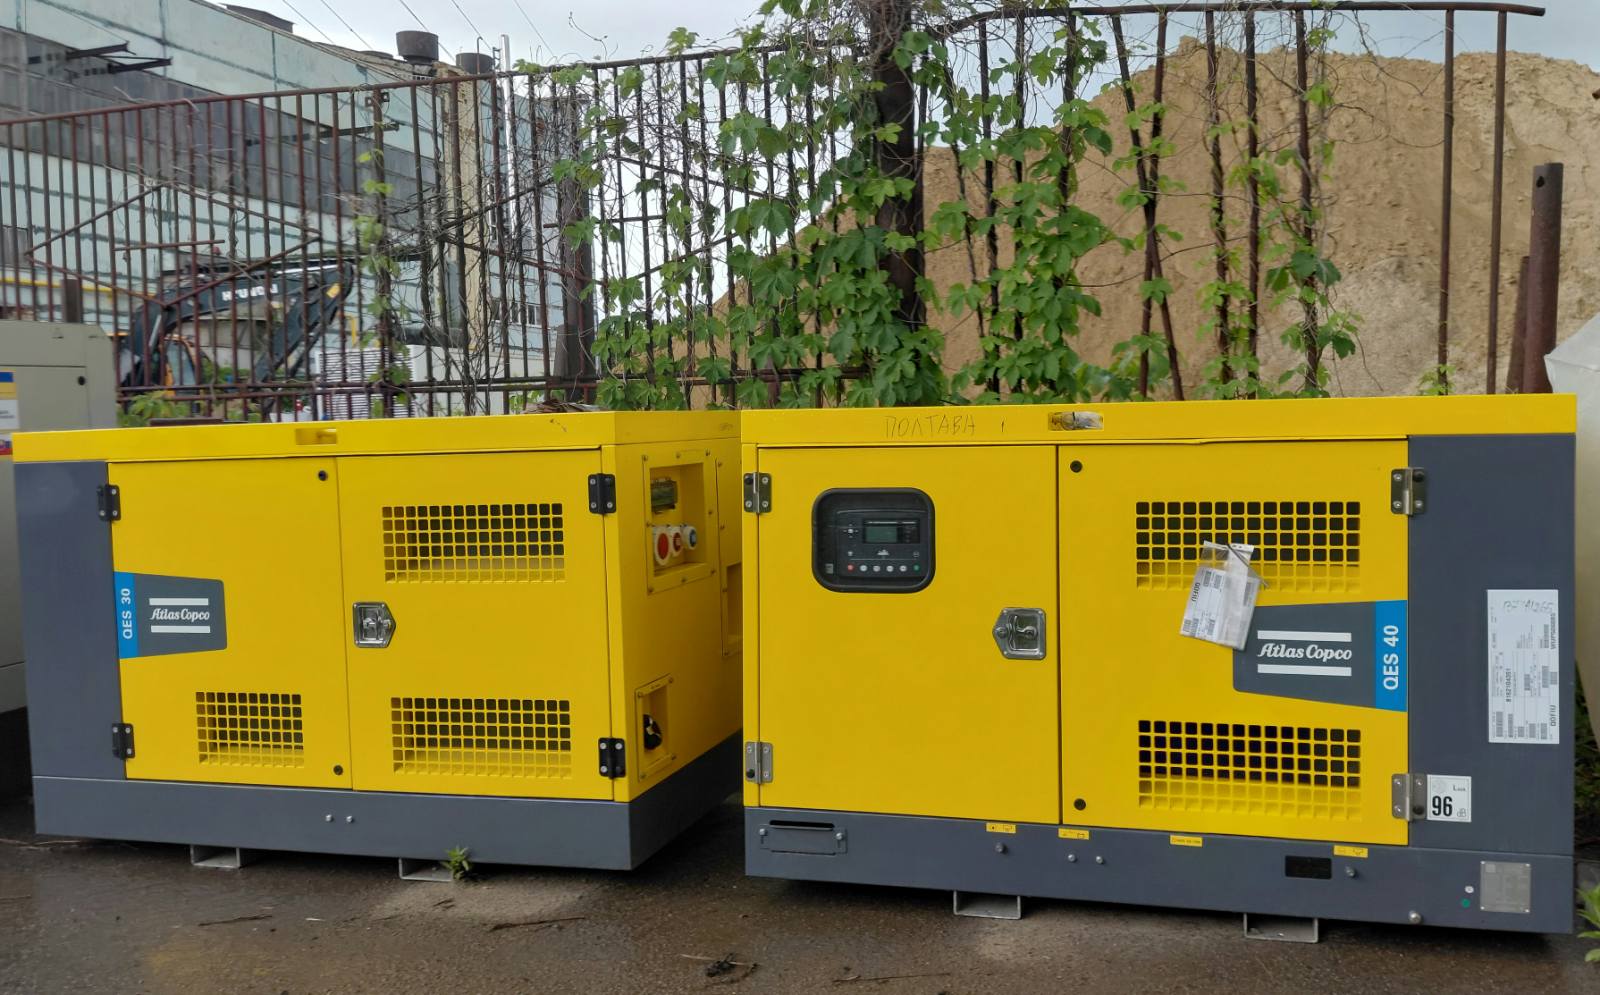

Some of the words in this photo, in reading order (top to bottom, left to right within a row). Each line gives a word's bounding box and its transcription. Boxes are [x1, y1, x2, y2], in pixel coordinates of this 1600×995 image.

[120, 588, 131, 605] 30
[122, 610, 133, 640] QES
[150, 608, 180, 621] Atlas
[180, 608, 210, 622] Copco
[1383, 625, 1399, 647] 40
[1257, 642, 1305, 659] Atlas
[1305, 643, 1352, 662] Copco
[1383, 653, 1399, 690] QES
[1432, 796, 1452, 817] 96
